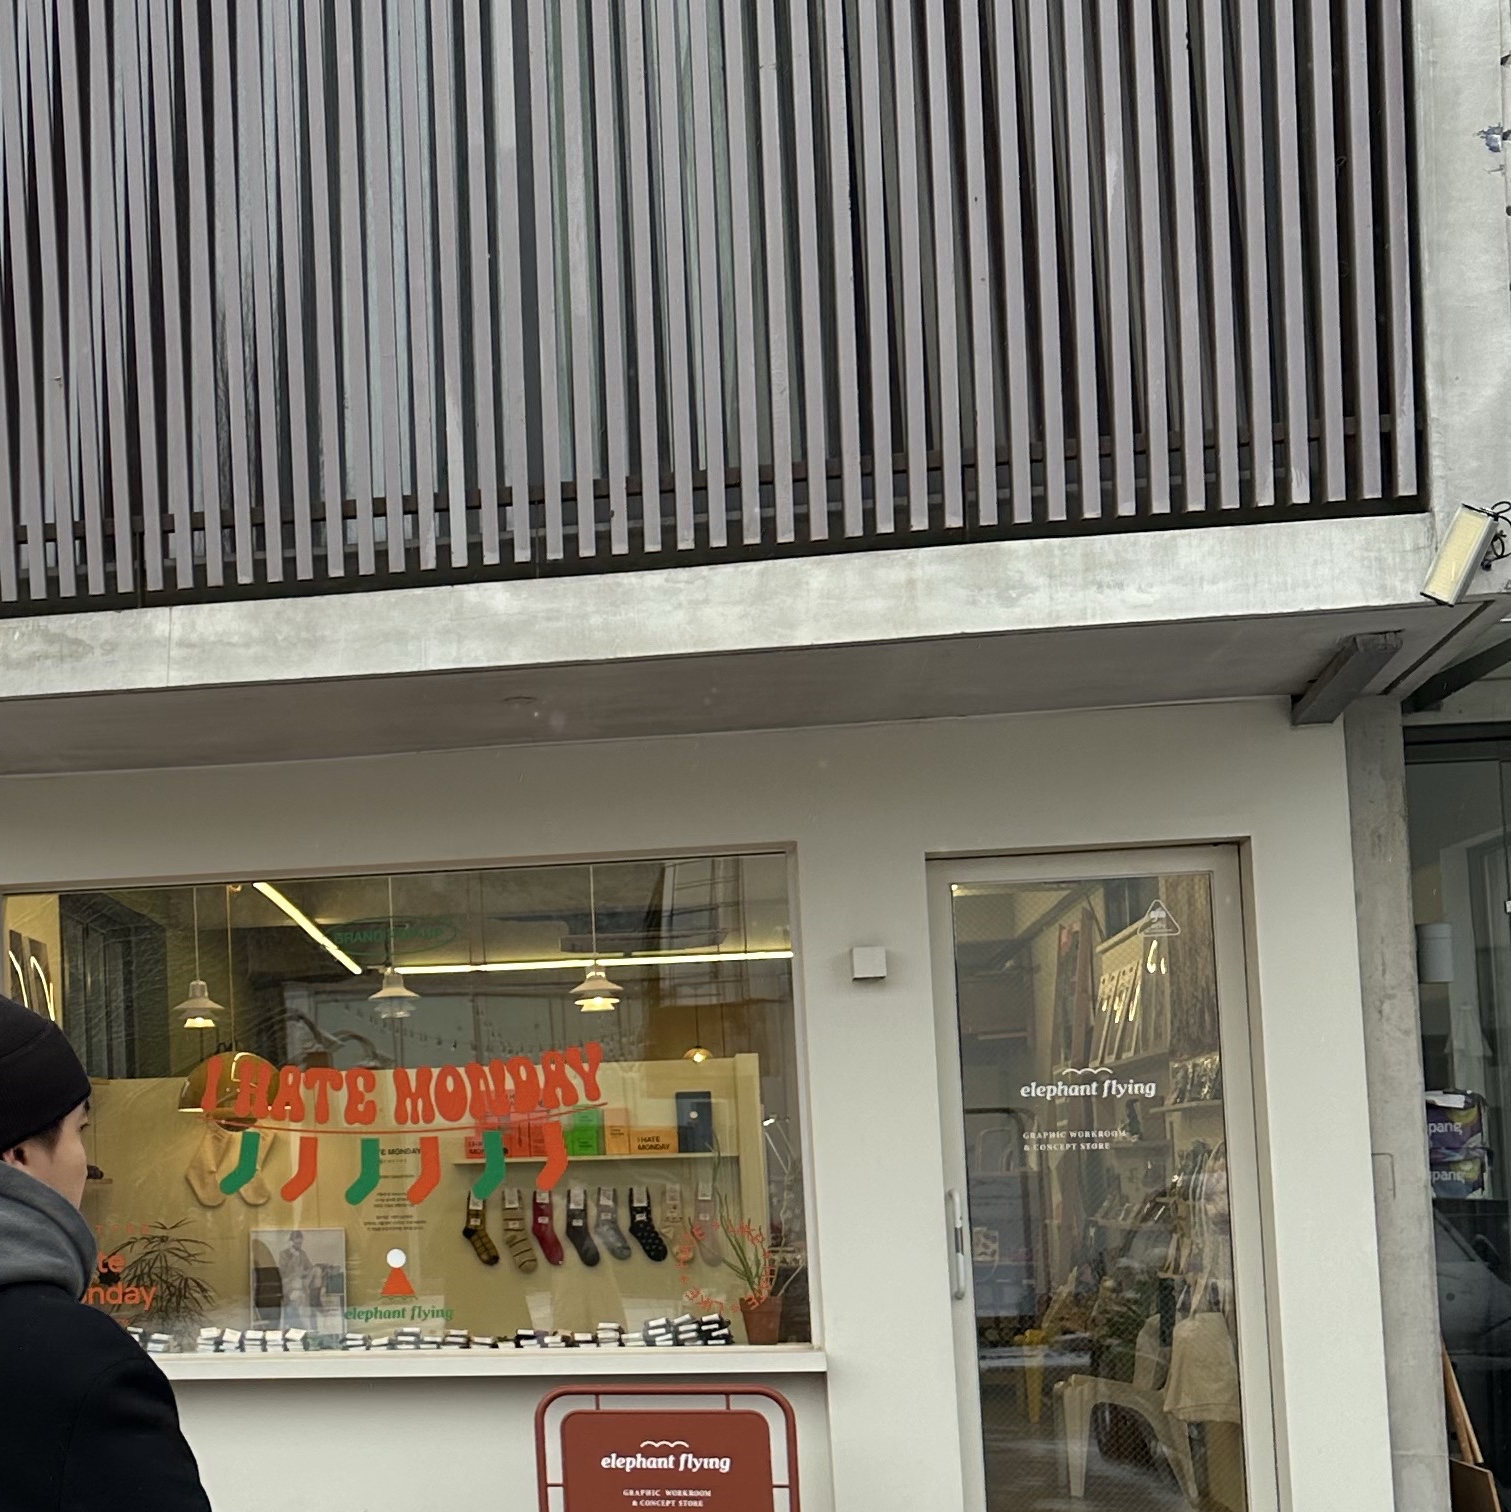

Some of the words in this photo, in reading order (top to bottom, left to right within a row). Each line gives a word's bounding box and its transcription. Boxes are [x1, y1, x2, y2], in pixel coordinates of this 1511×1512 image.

[200, 1057, 223, 1111] I
[234, 1056, 377, 1126] HATE
[392, 1041, 603, 1126] MONDAY
[1020, 1081, 1098, 1100] elephant
[1102, 1079, 1156, 1099] flying
[1022, 1131, 1066, 1139] GRAPHIC
[1069, 1130, 1127, 1139] WORKROOM
[1034, 1143, 1076, 1151] CONCEPT
[1080, 1142, 1111, 1150] STORE
[85, 1281, 157, 1311] nday
[343, 1306, 407, 1322] elephant
[410, 1304, 455, 1322] flying
[600, 1453, 675, 1472] elephant
[678, 1453, 731, 1473] flying
[622, 1489, 661, 1497] GRAPHIC
[665, 1489, 712, 1497] WORKROOM
